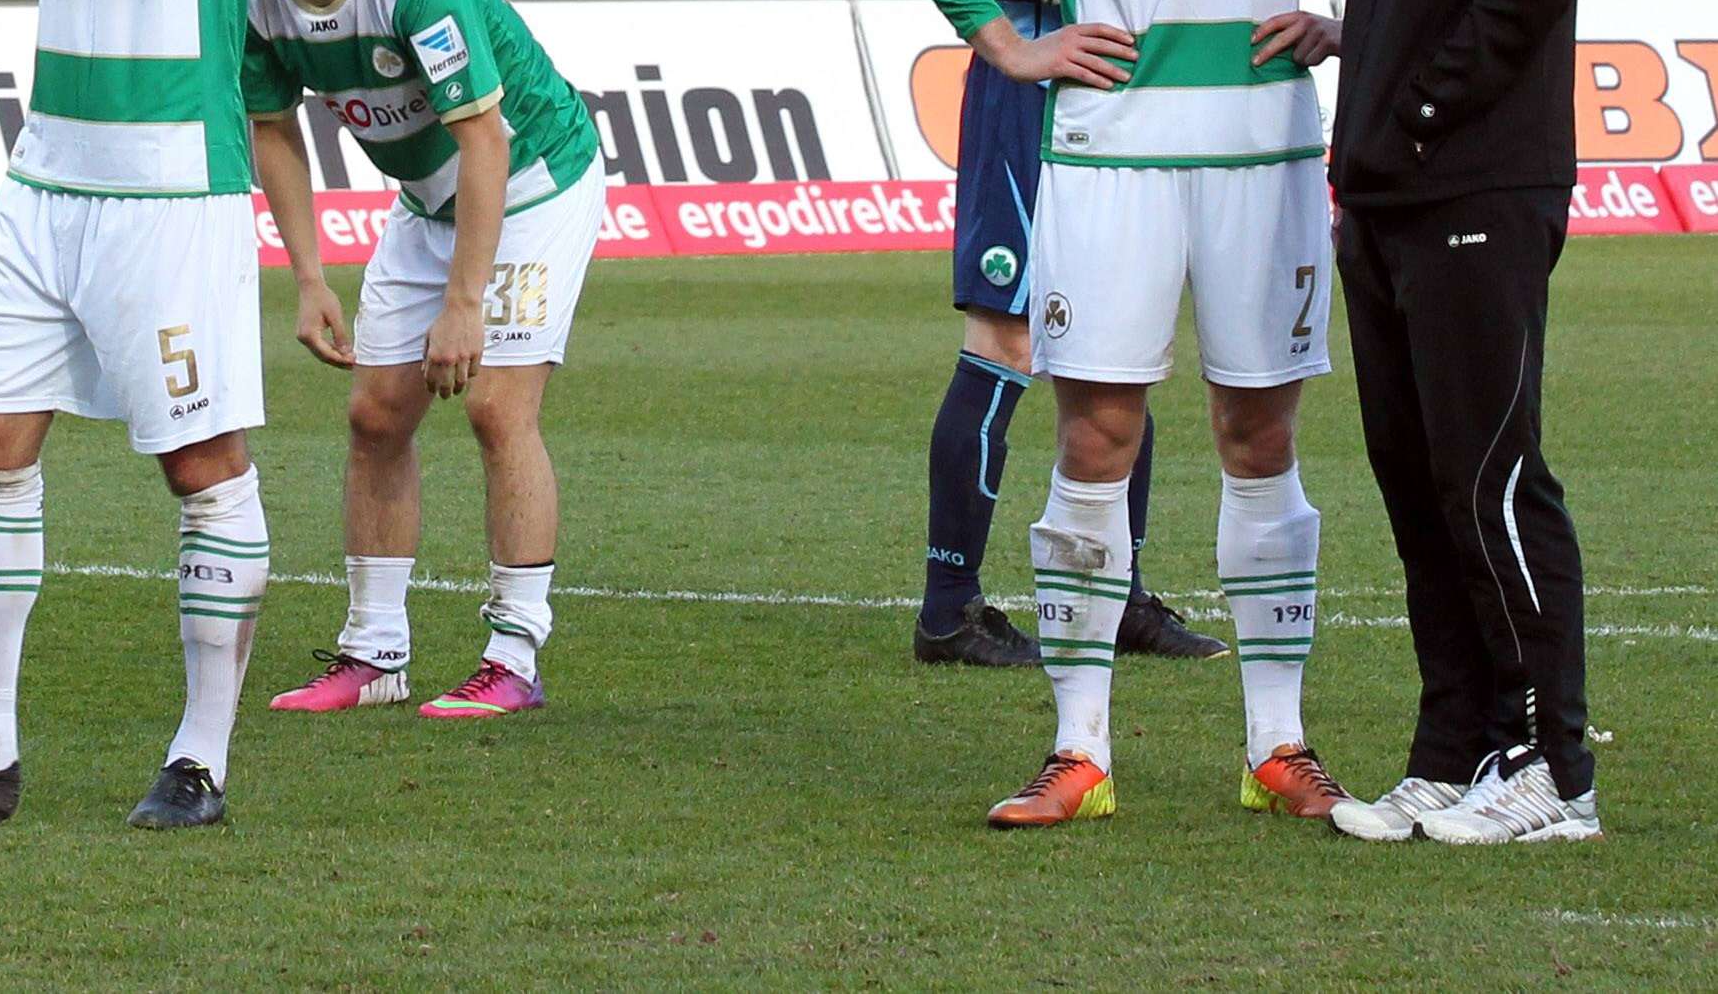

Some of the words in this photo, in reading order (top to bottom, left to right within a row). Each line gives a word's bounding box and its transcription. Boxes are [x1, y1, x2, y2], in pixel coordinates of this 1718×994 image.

[310, 19, 338, 32] JAKO
[429, 49, 467, 76] Hermes
[1460, 232, 1487, 245] JAKO
[483, 263, 547, 326] 38
[1292, 266, 1315, 337] 2
[504, 331, 532, 342] JAKO
[157, 324, 199, 398] 5
[186, 398, 210, 414] JAKO
